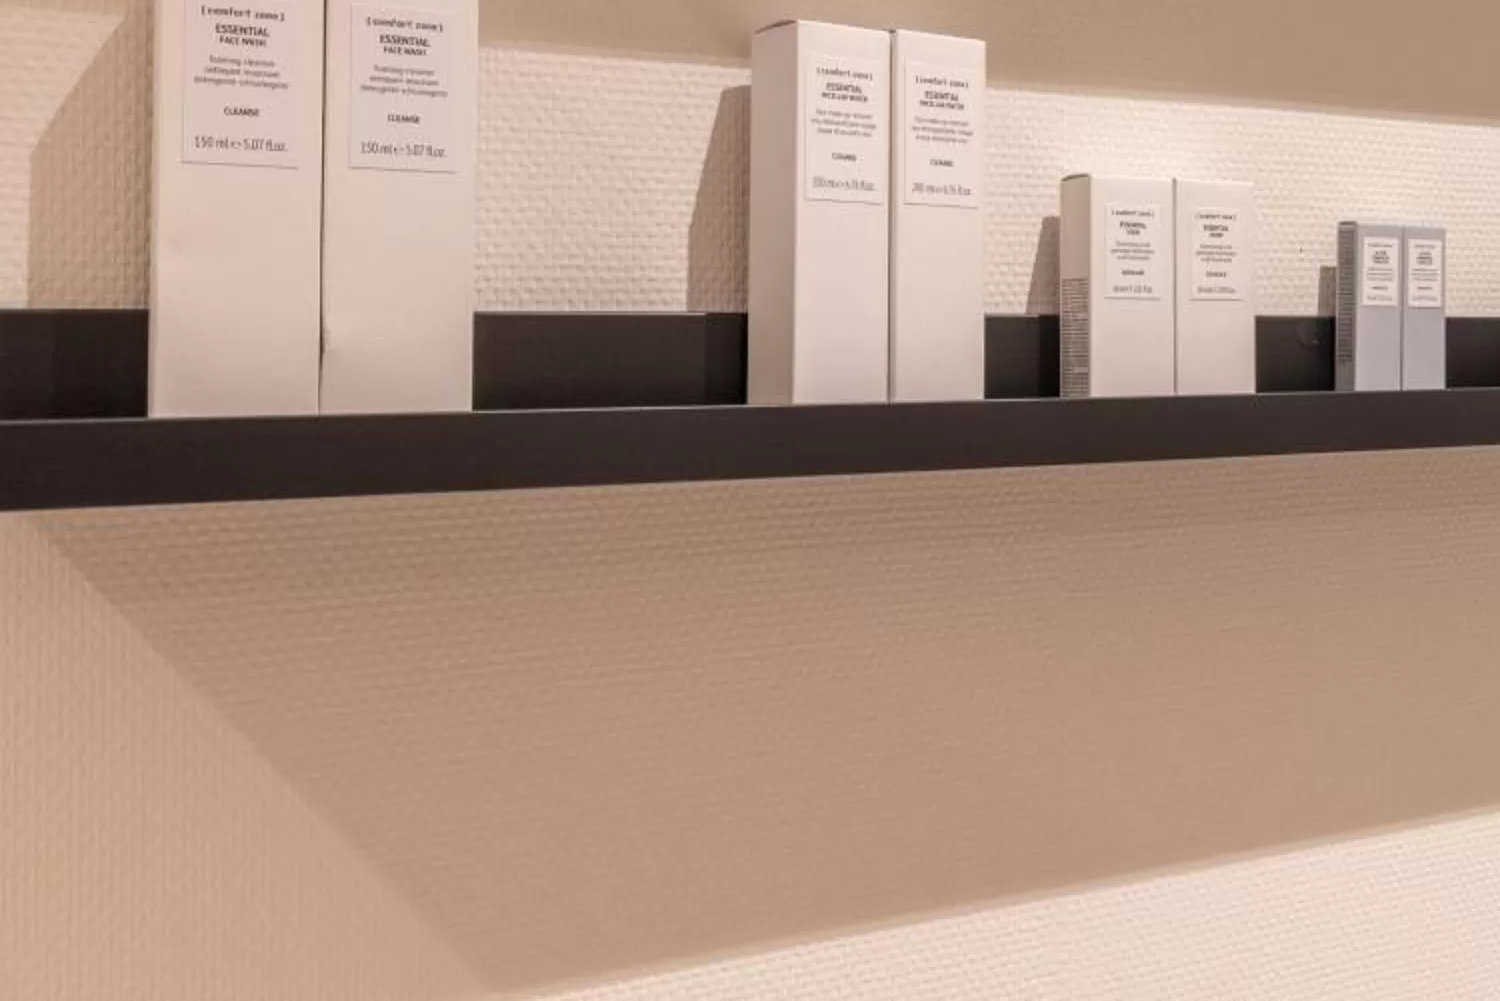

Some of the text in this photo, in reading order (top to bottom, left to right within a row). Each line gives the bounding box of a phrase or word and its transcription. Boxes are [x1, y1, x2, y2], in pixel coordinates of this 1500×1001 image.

[215, 23, 269, 37] ESSENTIAL
[220, 36, 240, 46] FACE
[379, 34, 430, 47] ESSENTIAL
[223, 105, 260, 116] CLEANSE
[387, 114, 420, 124] CLEANSE
[194, 135, 213, 148] 150
[361, 141, 378, 154] 150
